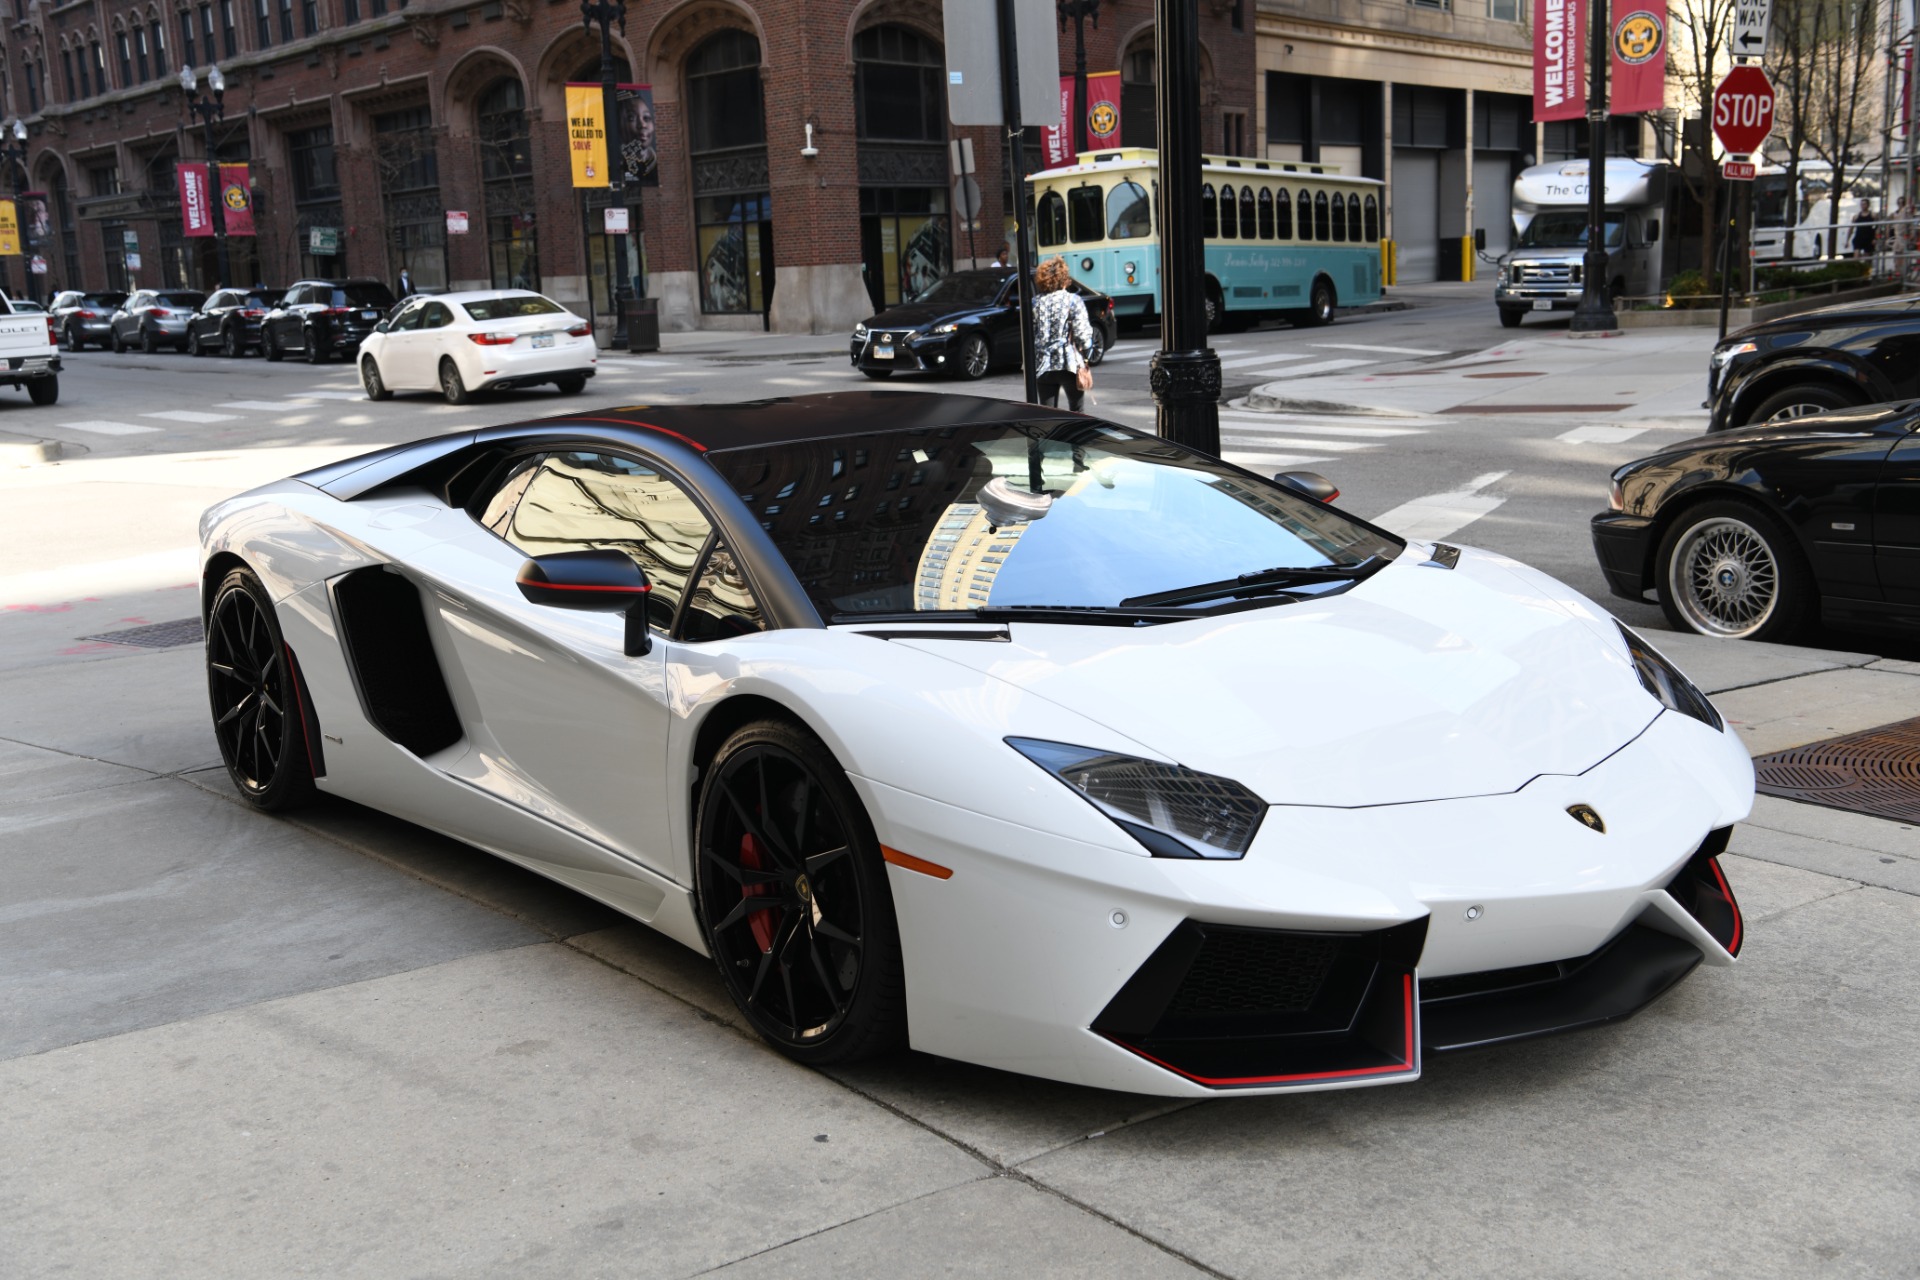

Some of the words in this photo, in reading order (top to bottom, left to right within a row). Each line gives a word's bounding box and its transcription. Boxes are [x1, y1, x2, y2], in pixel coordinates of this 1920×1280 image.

[1566, 1, 1577, 37] CAMPUS
[1739, 9, 1767, 27] WAY
[1545, 0, 1564, 108] WELCOME
[1566, 37, 1576, 68] TOWER
[1566, 70, 1576, 99] WATER
[571, 118, 581, 127] WE
[582, 118, 594, 127] ARE
[1716, 93, 1772, 127] STOP
[572, 129, 594, 138] CALLED
[595, 129, 603, 138] TO
[573, 141, 591, 150] SOLVE
[1048, 124, 1063, 164] WELC
[1727, 164, 1738, 176] ALL
[1740, 165, 1754, 177] WAY
[184, 171, 201, 229] WELCOME
[1546, 185, 1570, 195] The
